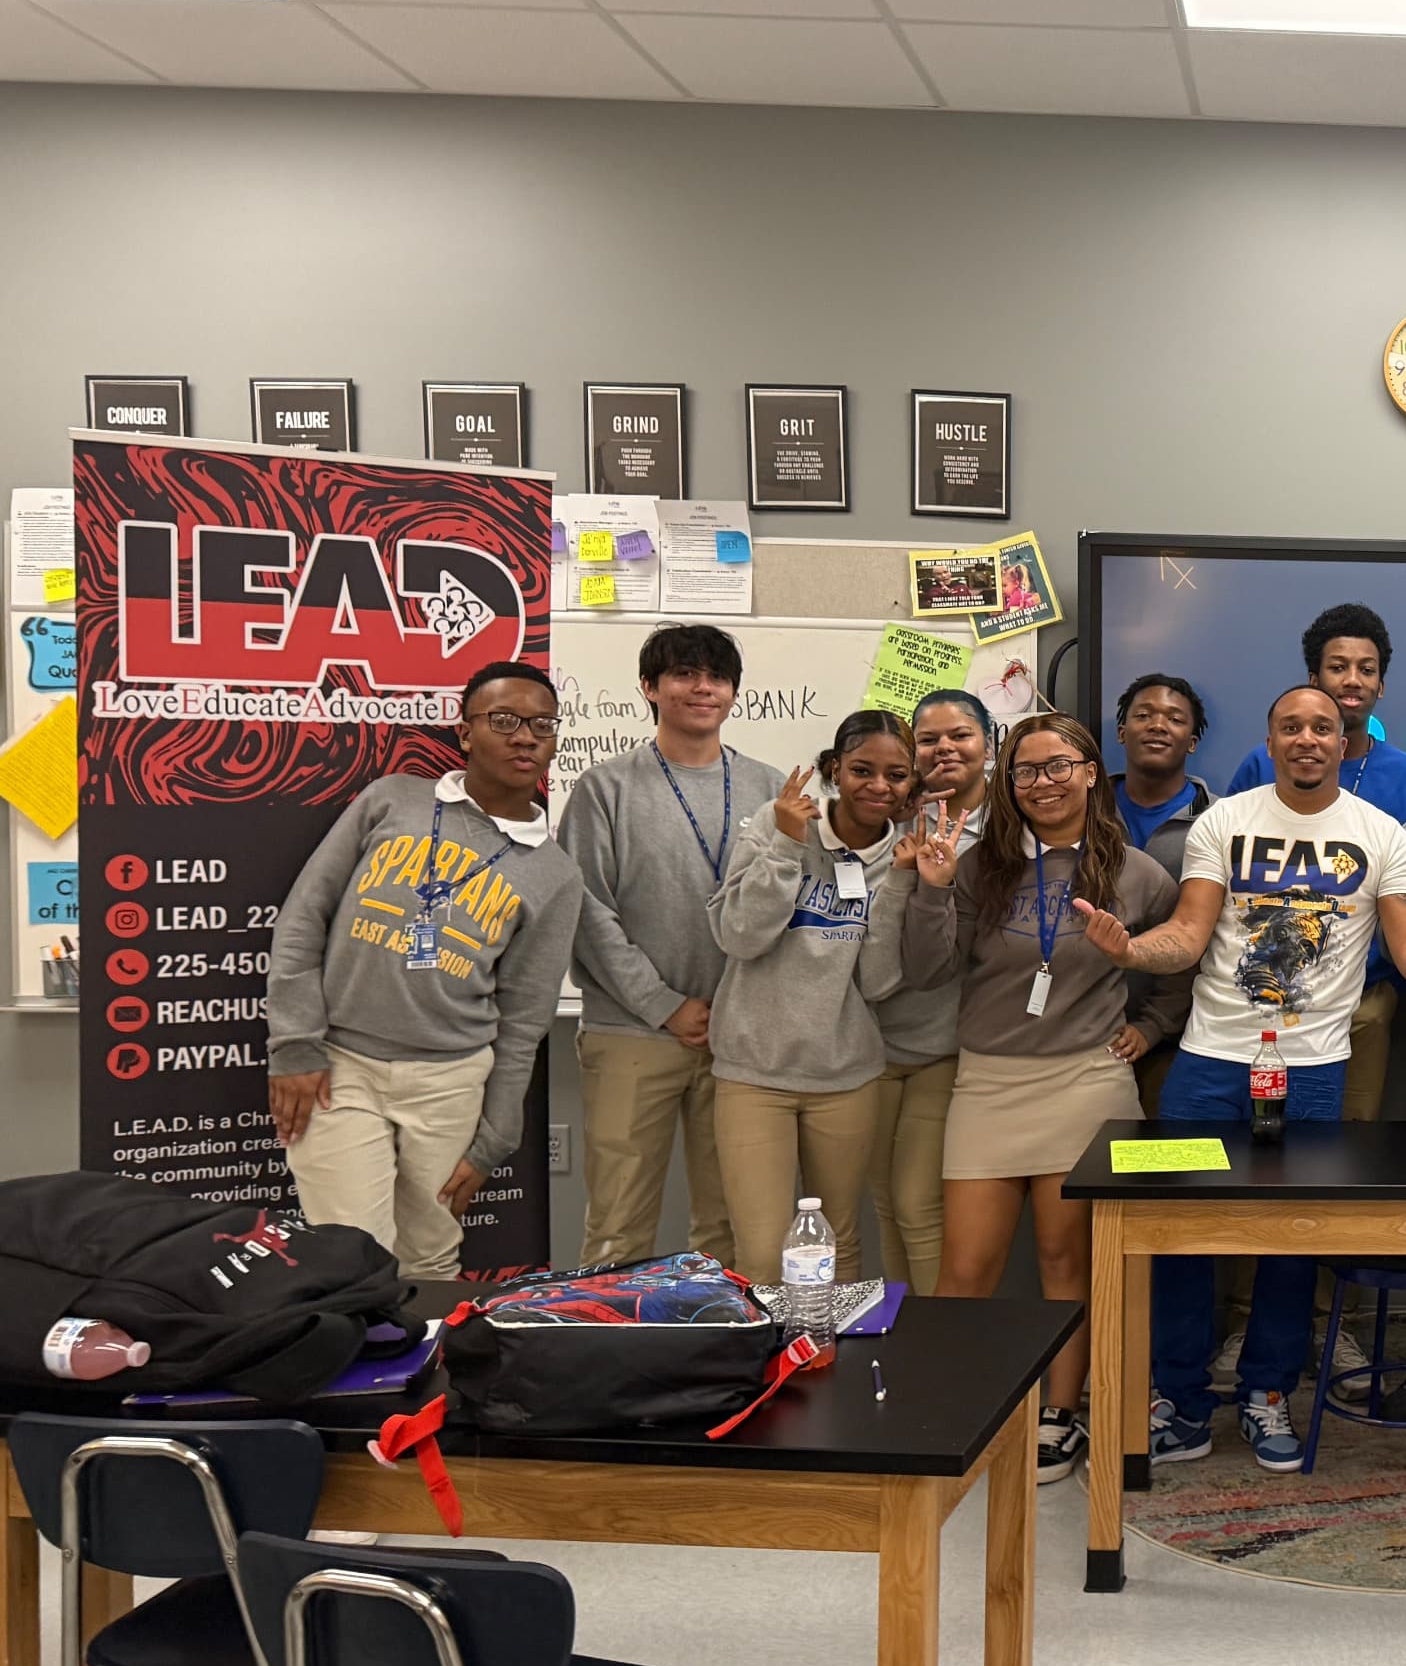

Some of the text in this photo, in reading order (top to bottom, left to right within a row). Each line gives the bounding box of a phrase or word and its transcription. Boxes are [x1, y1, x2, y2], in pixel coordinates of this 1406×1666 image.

[1394, 359, 1405, 376] 9
[107, 406, 167, 425] CONQUER
[275, 411, 330, 429] FAILURE
[455, 415, 496, 433] GOAL
[613, 416, 659, 433] GRIND
[780, 419, 815, 436] GRIT
[935, 422, 988, 442] HUSTLE
[117, 520, 526, 689] LEAD
[96, 685, 463, 722] LoveEducateAdvocateD
[156, 860, 227, 883] LEAD
[1230, 835, 1368, 896] LEAD
[39, 903, 58, 918] of
[821, 930, 864, 942] SPARTA
[351, 917, 388, 946] EAST
[384, 929, 475, 980] ASSION
[156, 1043, 266, 1072] PAYPAL.
[113, 1111, 277, 1136] L.E.A.D. is a Chr
[113, 1137, 286, 1164] organization crea
[151, 1161, 262, 1183] community
[268, 1159, 288, 1177] by
[491, 1165, 513, 1179] on
